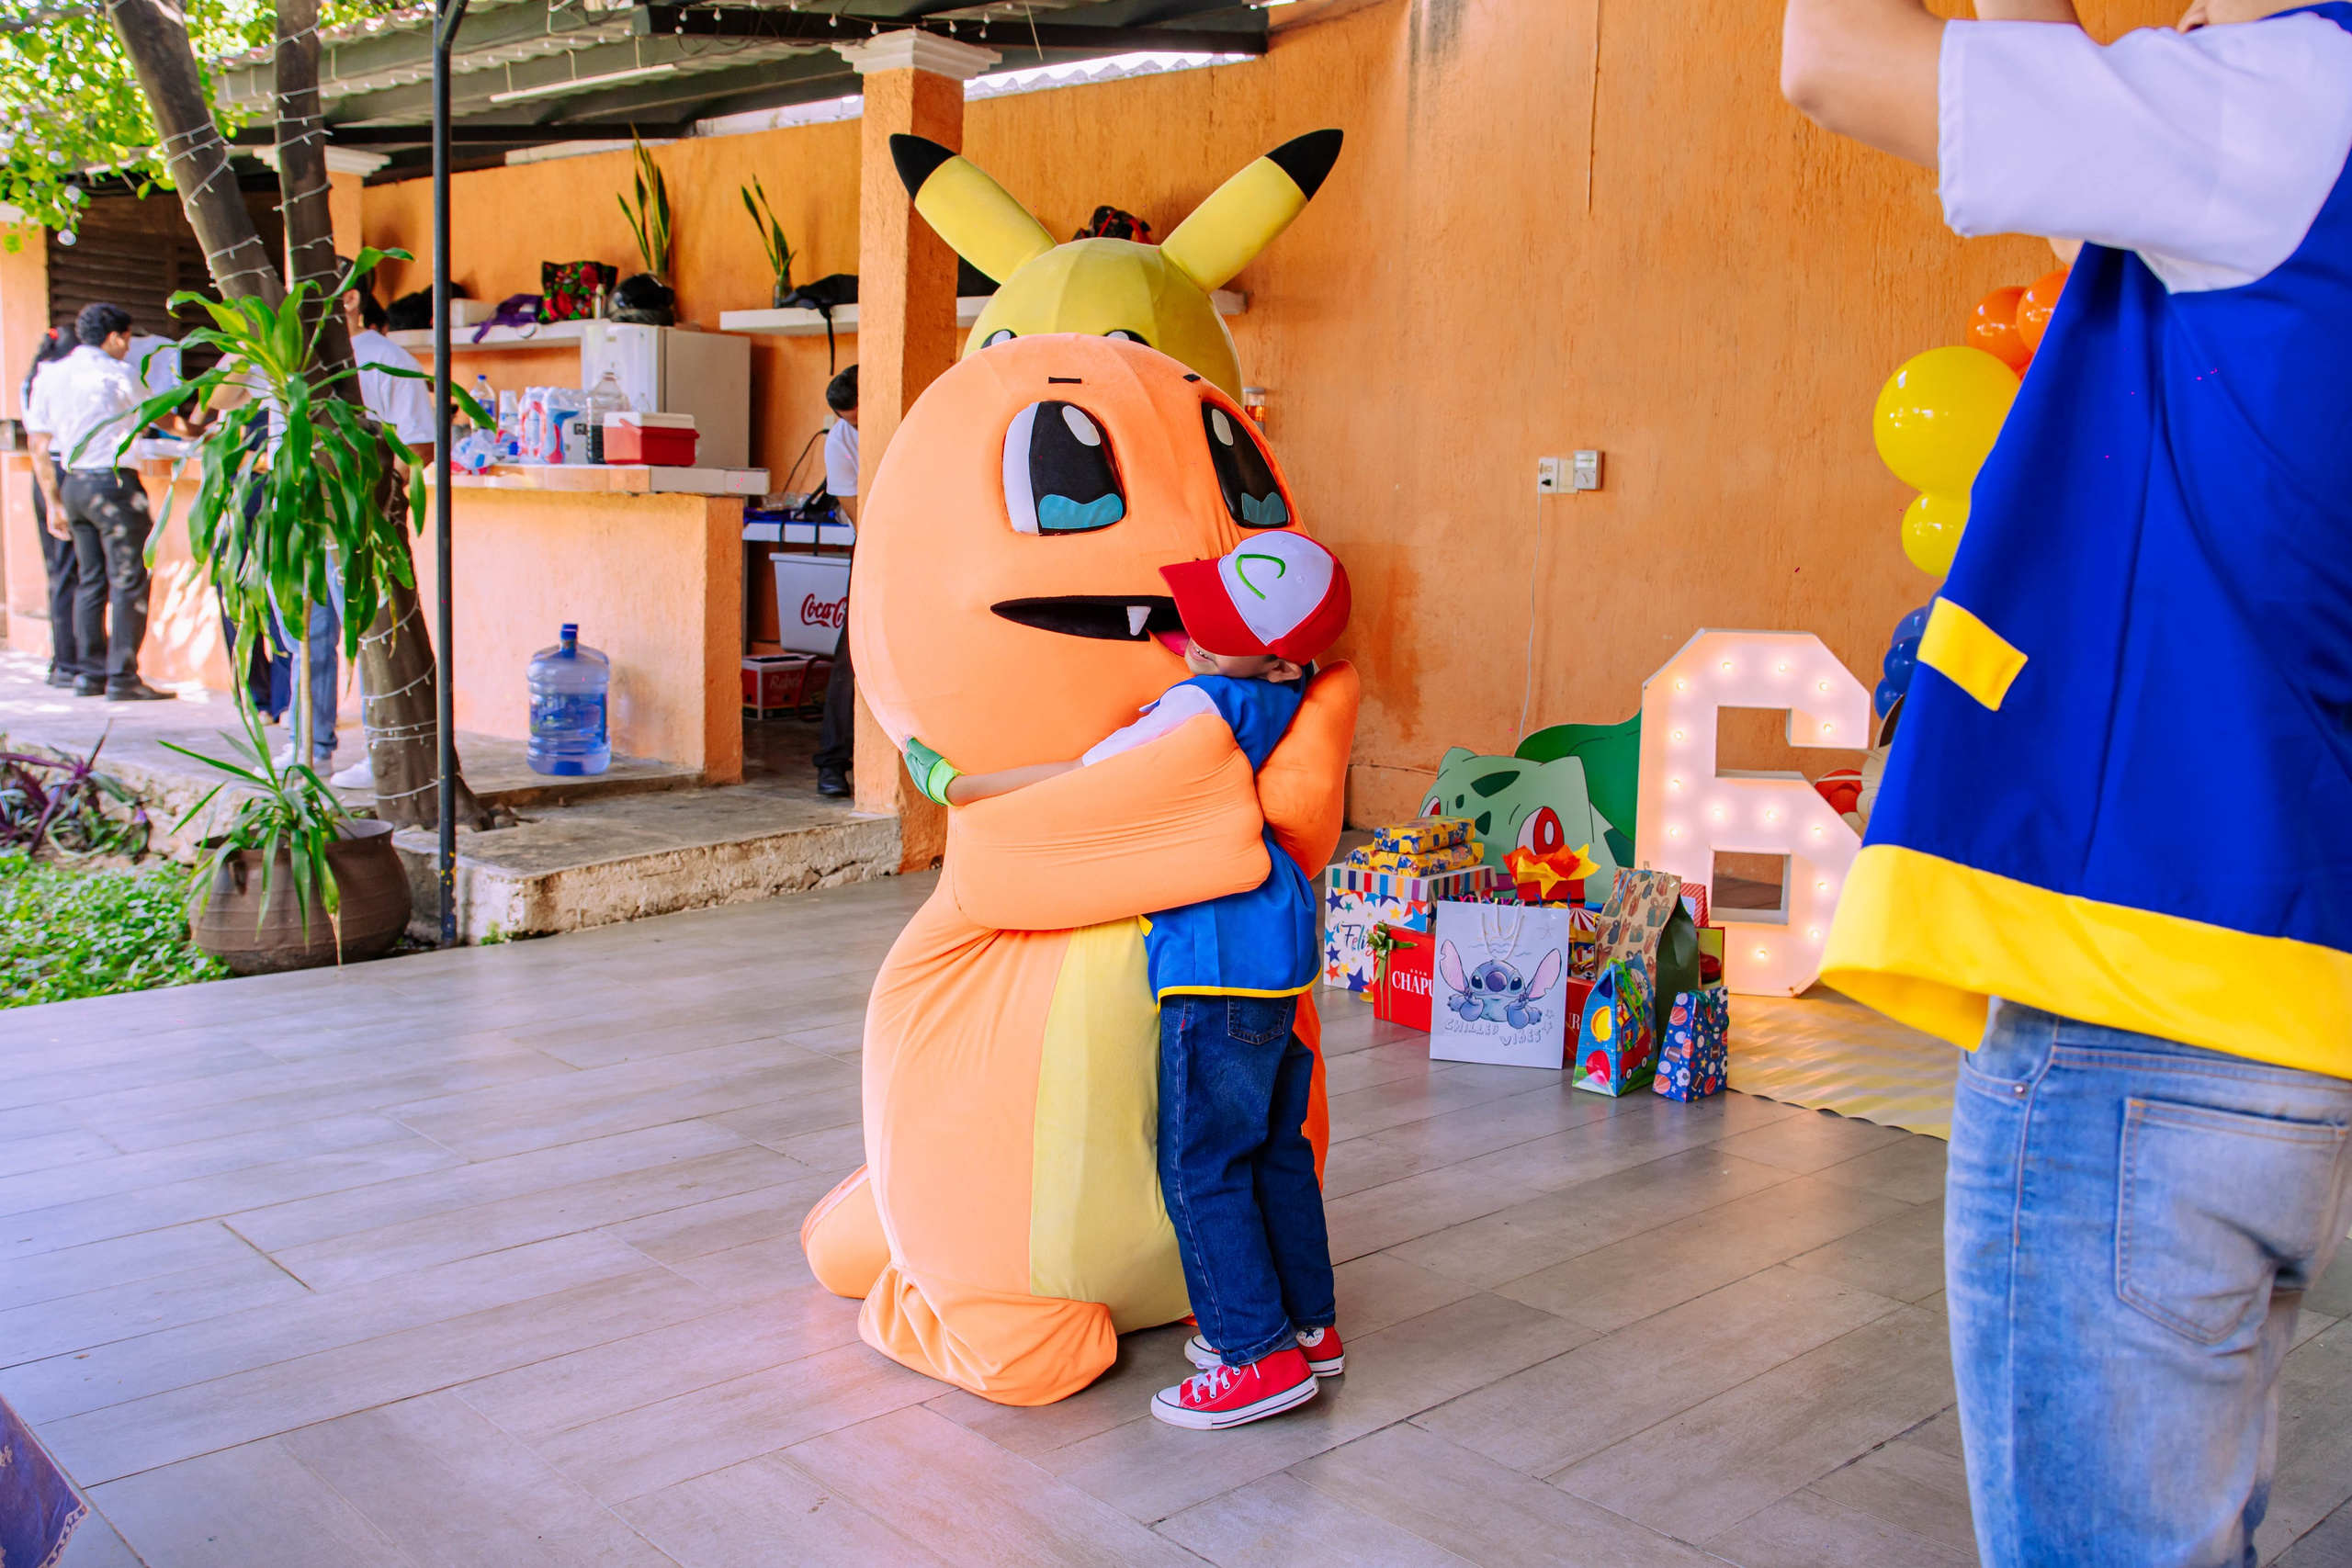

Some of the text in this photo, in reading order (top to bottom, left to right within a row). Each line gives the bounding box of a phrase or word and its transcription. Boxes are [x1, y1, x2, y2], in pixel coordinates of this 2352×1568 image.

[1340, 924, 1374, 957] Feli
[1444, 1019, 1542, 1046] CHILLED VIBES
